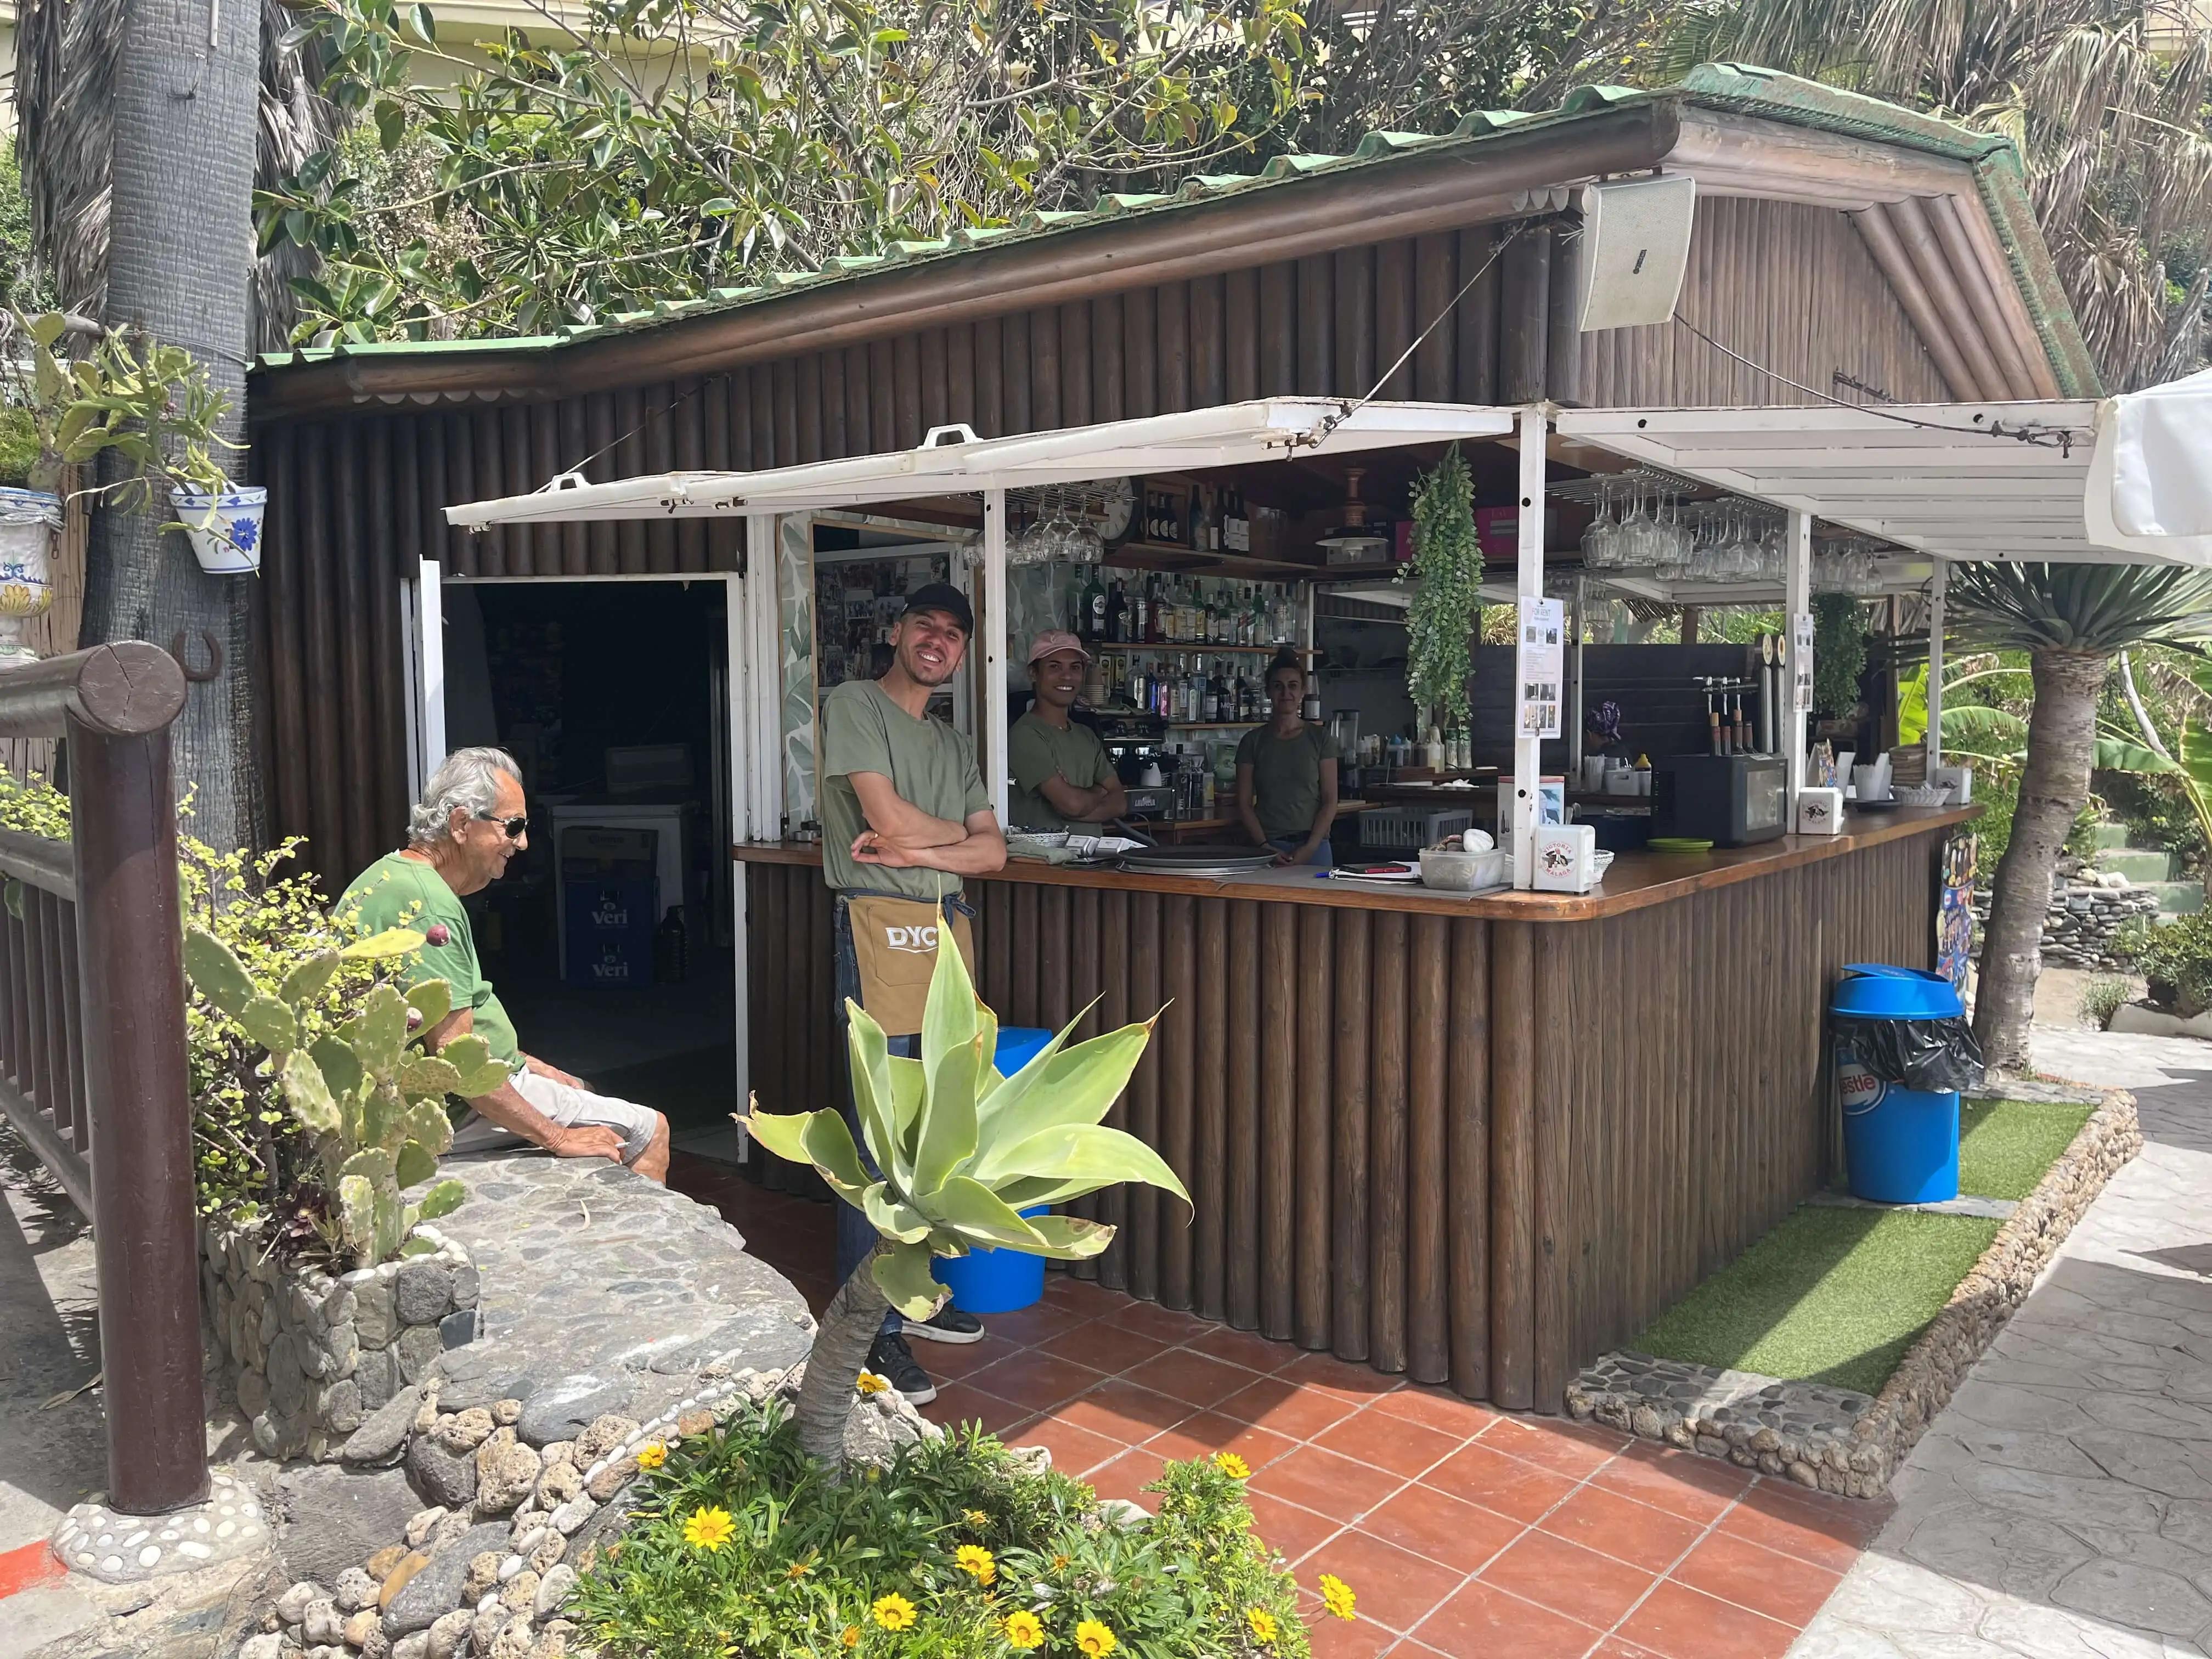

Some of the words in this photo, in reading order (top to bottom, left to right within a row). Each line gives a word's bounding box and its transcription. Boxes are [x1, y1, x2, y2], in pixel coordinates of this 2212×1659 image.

[1543, 843, 1572, 854] VICTORIA
[591, 909, 628, 925] Veri
[885, 926, 938, 947] DYC
[591, 961, 629, 978] Veri
